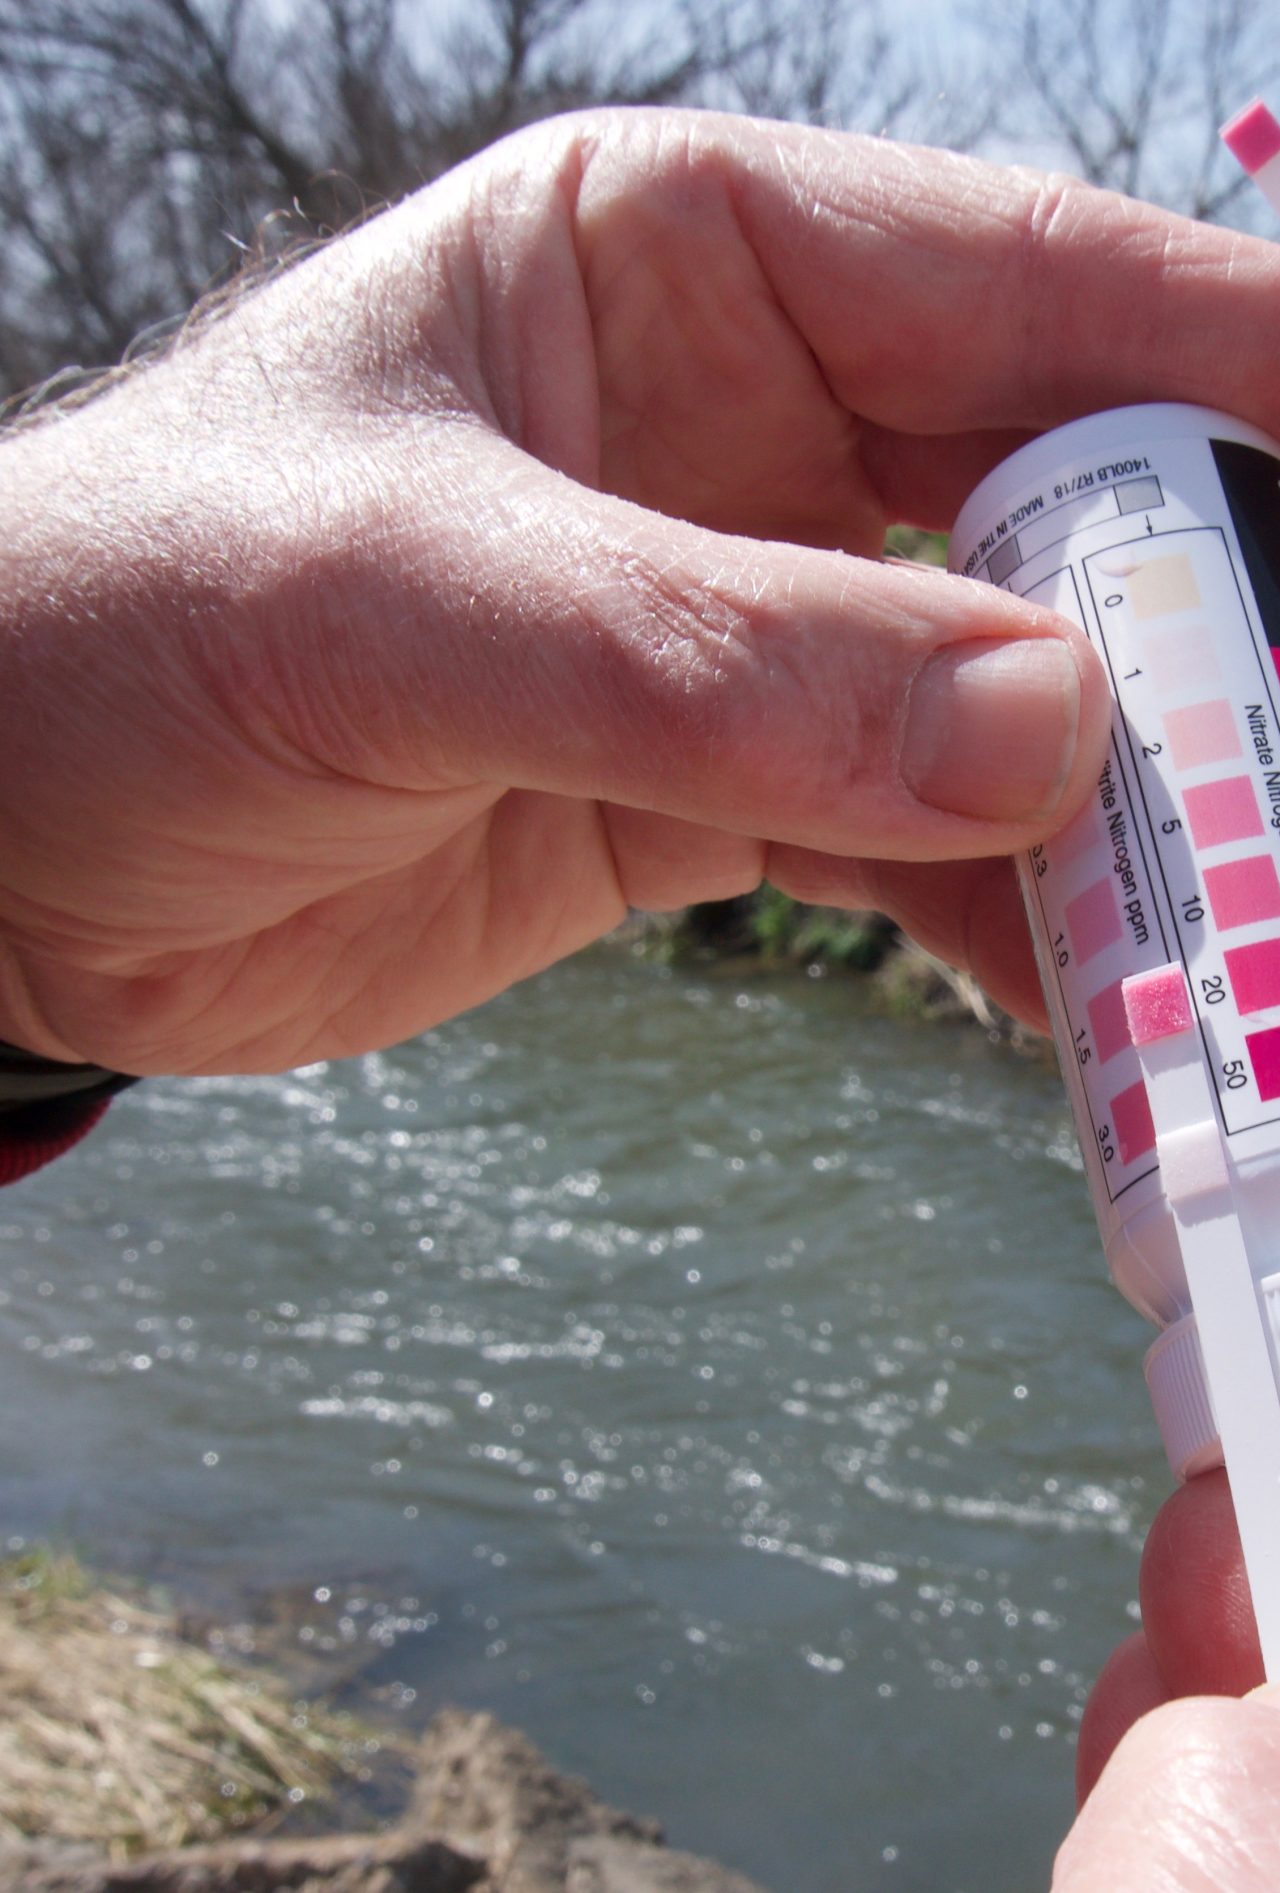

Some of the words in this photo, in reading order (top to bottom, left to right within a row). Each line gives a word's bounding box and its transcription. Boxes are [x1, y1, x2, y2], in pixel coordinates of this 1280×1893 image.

[1097, 457, 1152, 482] 1400LB
[1054, 472, 1094, 500] R7/18
[1010, 495, 1045, 526] MADE
[977, 532, 997, 557] THE
[996, 521, 1008, 539] IN
[1105, 594, 1123, 608] 0
[1124, 668, 1143, 680] 1
[1245, 704, 1275, 766] Nitrate
[1142, 742, 1162, 759] 2
[1162, 818, 1182, 834] 5
[1106, 810, 1138, 897] Nitrogen
[1124, 899, 1150, 947] ppm
[1181, 894, 1205, 923] 10
[1055, 933, 1069, 968] 1.0
[1201, 975, 1226, 1005] 20
[1075, 1027, 1092, 1065] 1.5
[1223, 1060, 1248, 1090] 50
[1098, 1124, 1115, 1163] 3.0
